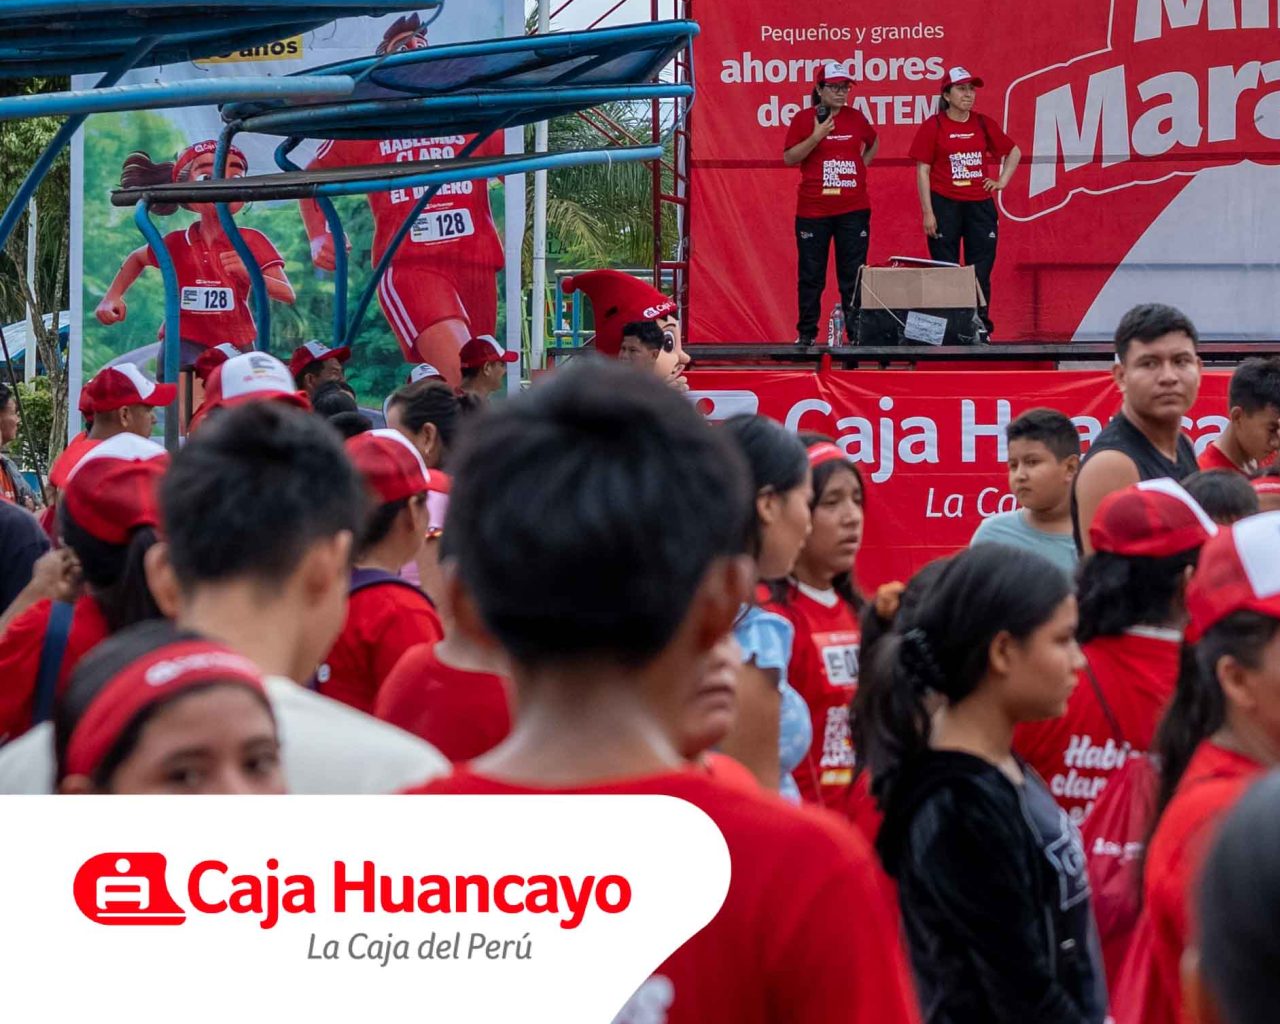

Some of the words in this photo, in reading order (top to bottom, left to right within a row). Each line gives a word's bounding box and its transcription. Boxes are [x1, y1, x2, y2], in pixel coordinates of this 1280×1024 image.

[761, 24, 851, 45] Pequeños
[856, 28, 866, 44] y
[871, 22, 945, 44] grandes
[848, 94, 942, 125] ATEM
[390, 188, 410, 204] EL
[436, 212, 466, 236] 128
[204, 290, 227, 309] 128
[784, 396, 940, 483] Caja
[926, 487, 963, 517] La
[977, 487, 1018, 517] Ca
[1051, 768, 1108, 799] clar
